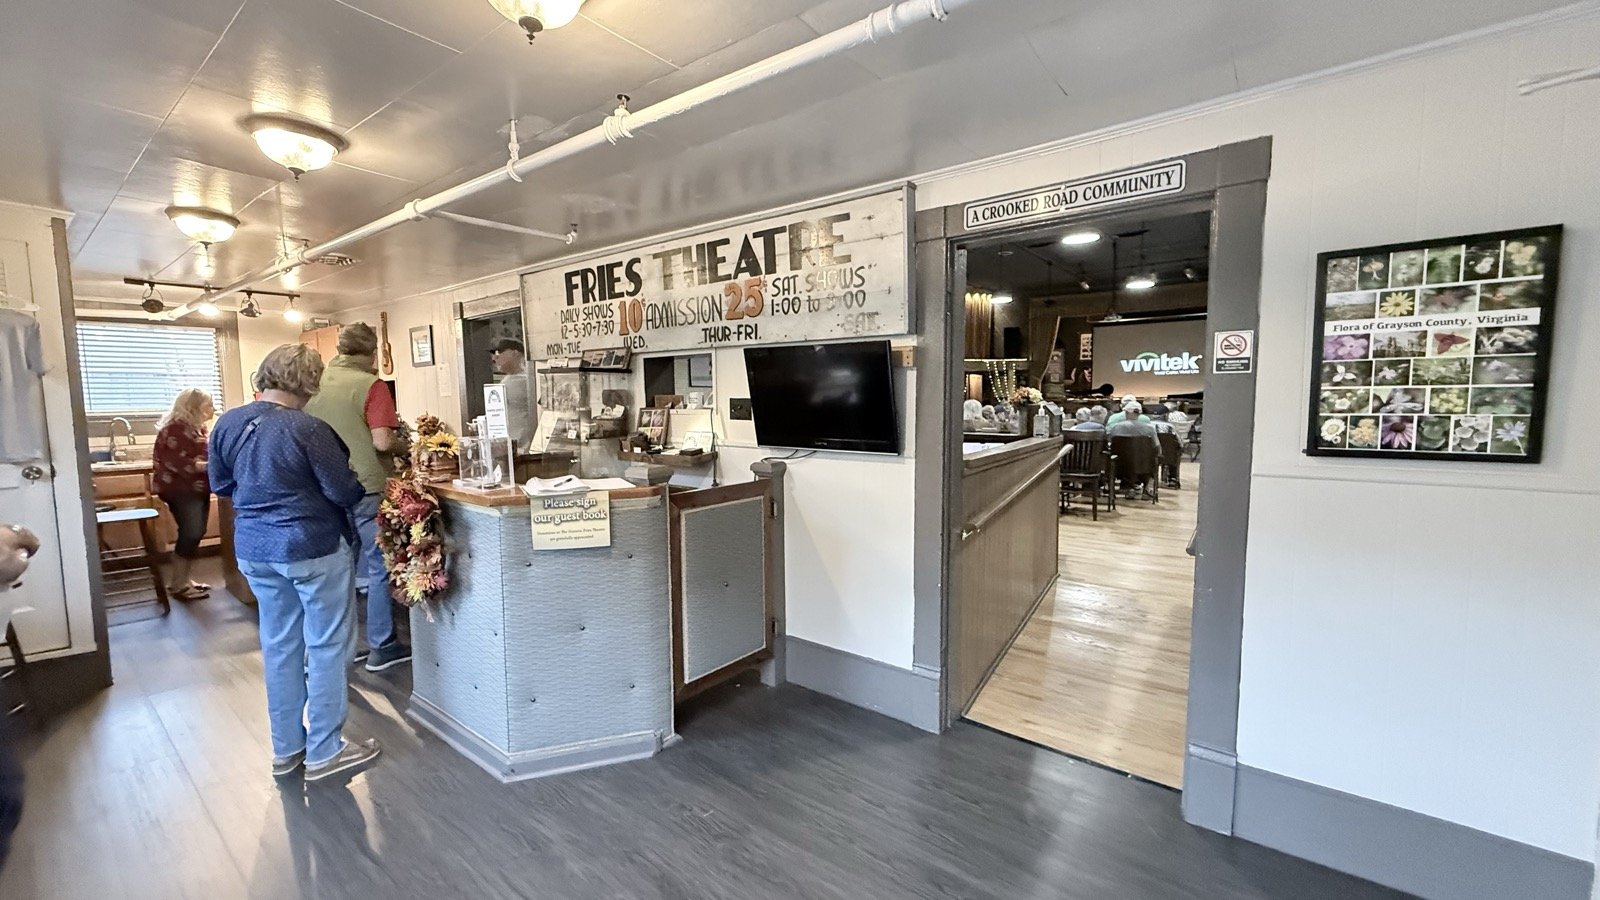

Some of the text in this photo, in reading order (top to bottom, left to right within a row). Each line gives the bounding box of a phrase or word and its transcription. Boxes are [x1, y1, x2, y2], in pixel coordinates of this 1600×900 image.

[971, 169, 1176, 223] A CROOKED ROAD COMMUNITY
[564, 212, 852, 306] FRIES THEATRE
[560, 303, 614, 325] DAILY SHOWS
[646, 293, 723, 331] ADMISSION
[771, 297, 801, 316] 1:00
[806, 295, 820, 313] to
[1333, 324, 1360, 332] Flora
[1362, 322, 1373, 331] of
[1377, 319, 1422, 331] Grayson
[1477, 313, 1528, 325] Virginia
[543, 497, 597, 510] Please sign
[534, 509, 607, 526] our guest book
